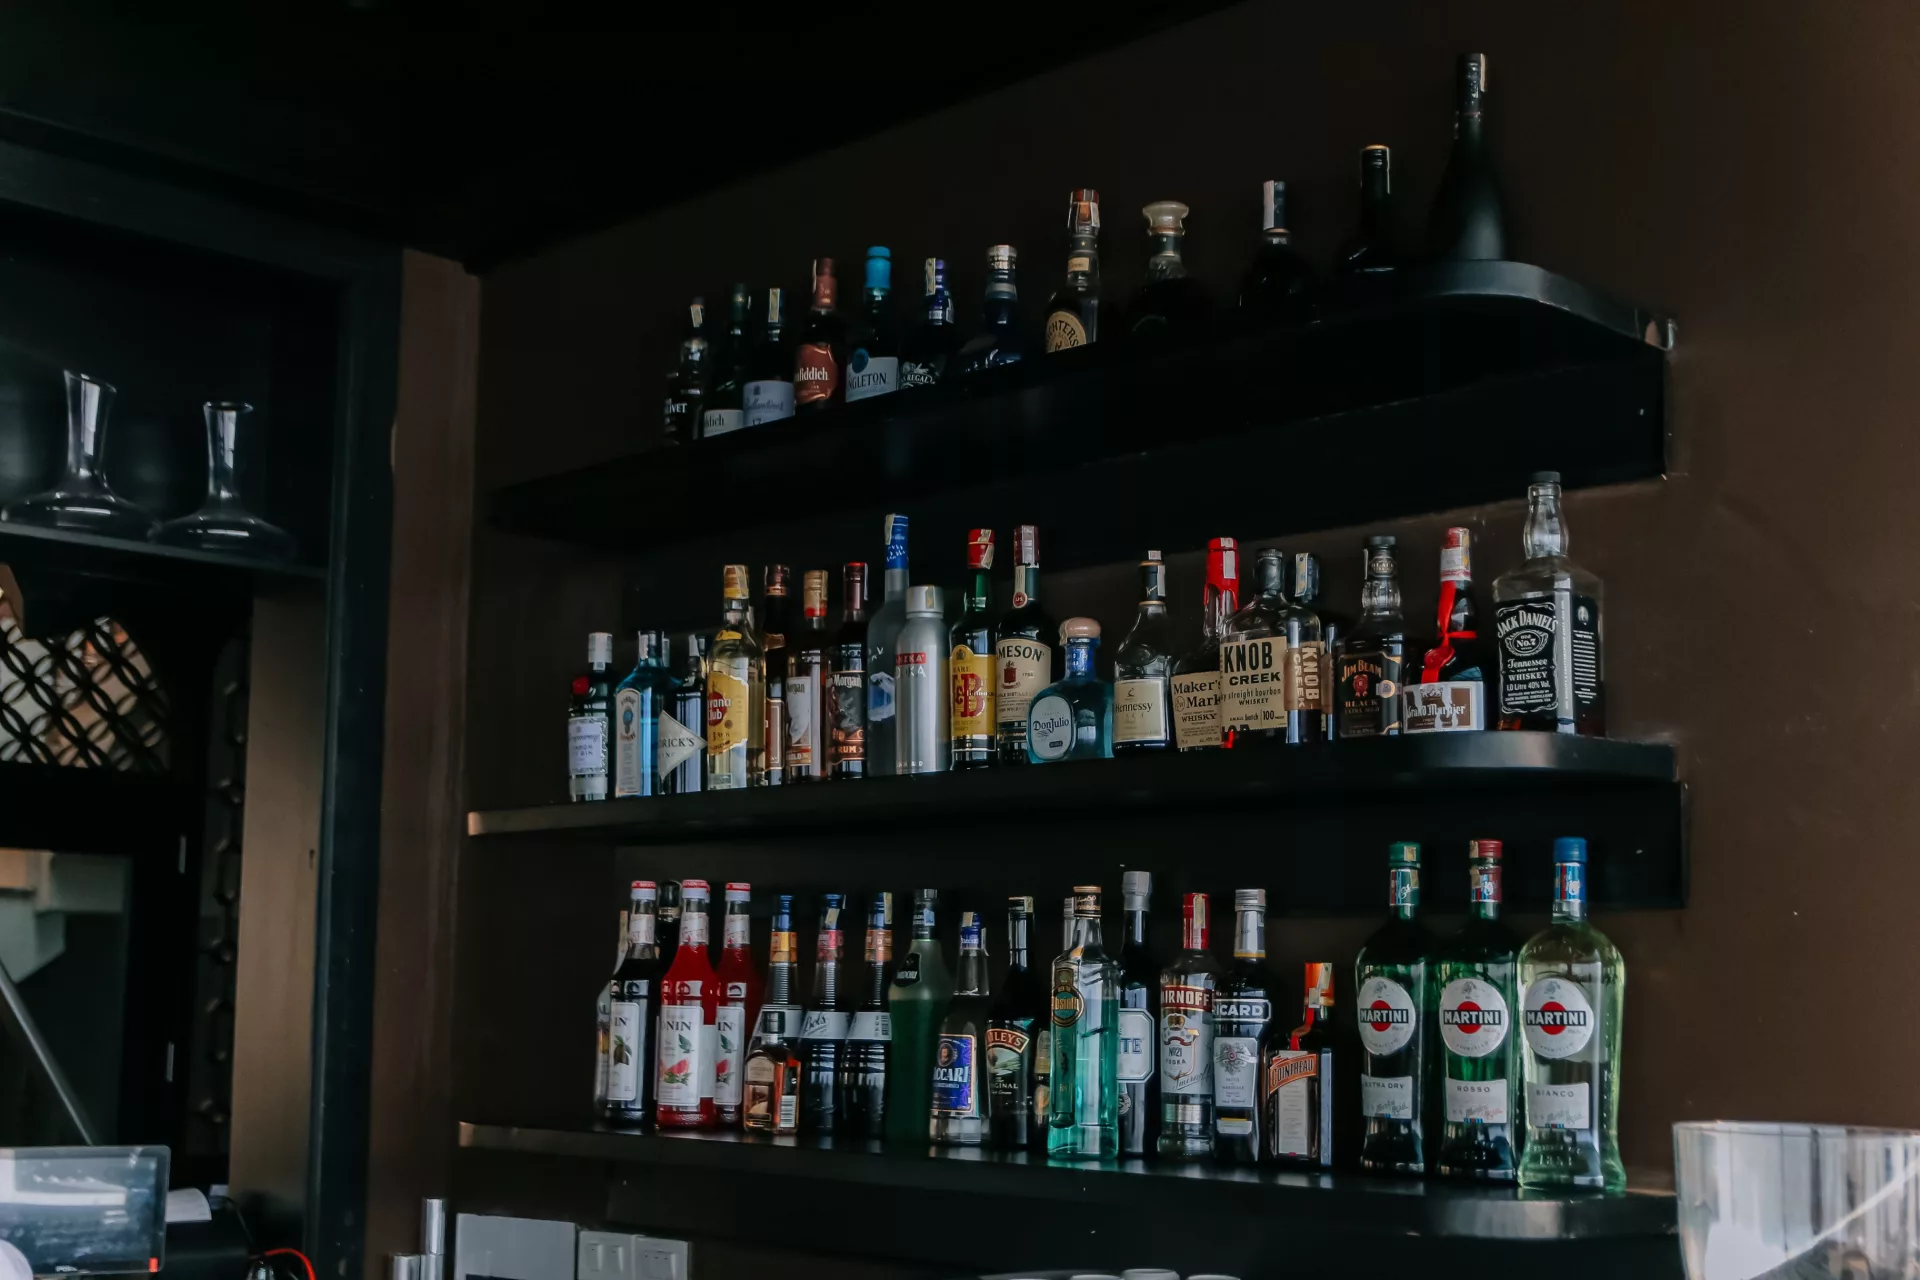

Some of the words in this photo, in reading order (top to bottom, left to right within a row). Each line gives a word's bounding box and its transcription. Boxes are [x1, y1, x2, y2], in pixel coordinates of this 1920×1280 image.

[1048, 319, 1079, 347] CHTER'S
[798, 366, 829, 381] fiddich
[1497, 615, 1519, 639] JACK
[1518, 610, 1559, 634] DANIEL'S
[997, 645, 1042, 662] MESON
[1224, 642, 1273, 674] KNOB
[1341, 664, 1357, 682] JIM
[1357, 659, 1382, 678] BEAM
[1507, 658, 1548, 669] Tennessee
[1229, 672, 1281, 686] CREEK
[1301, 647, 1320, 700] KNOB
[1508, 671, 1548, 681] WHISKEY
[1173, 679, 1221, 695] Maker's
[1228, 690, 1254, 701] straight
[1255, 686, 1282, 697] bourbon
[1115, 702, 1153, 713] Hennessy
[1186, 694, 1221, 709] Mark
[1238, 697, 1270, 706] WHISKEY
[1181, 713, 1218, 723] WHISKY
[1262, 710, 1275, 721] 100
[1360, 1010, 1408, 1023] MARTINI
[1444, 1011, 1500, 1025] MARTINI
[1527, 1012, 1586, 1026] MARTINI
[1271, 1058, 1314, 1087] COINTREAU
[1456, 1085, 1491, 1093] ROSSO
[1535, 1089, 1575, 1098] BIANCO
